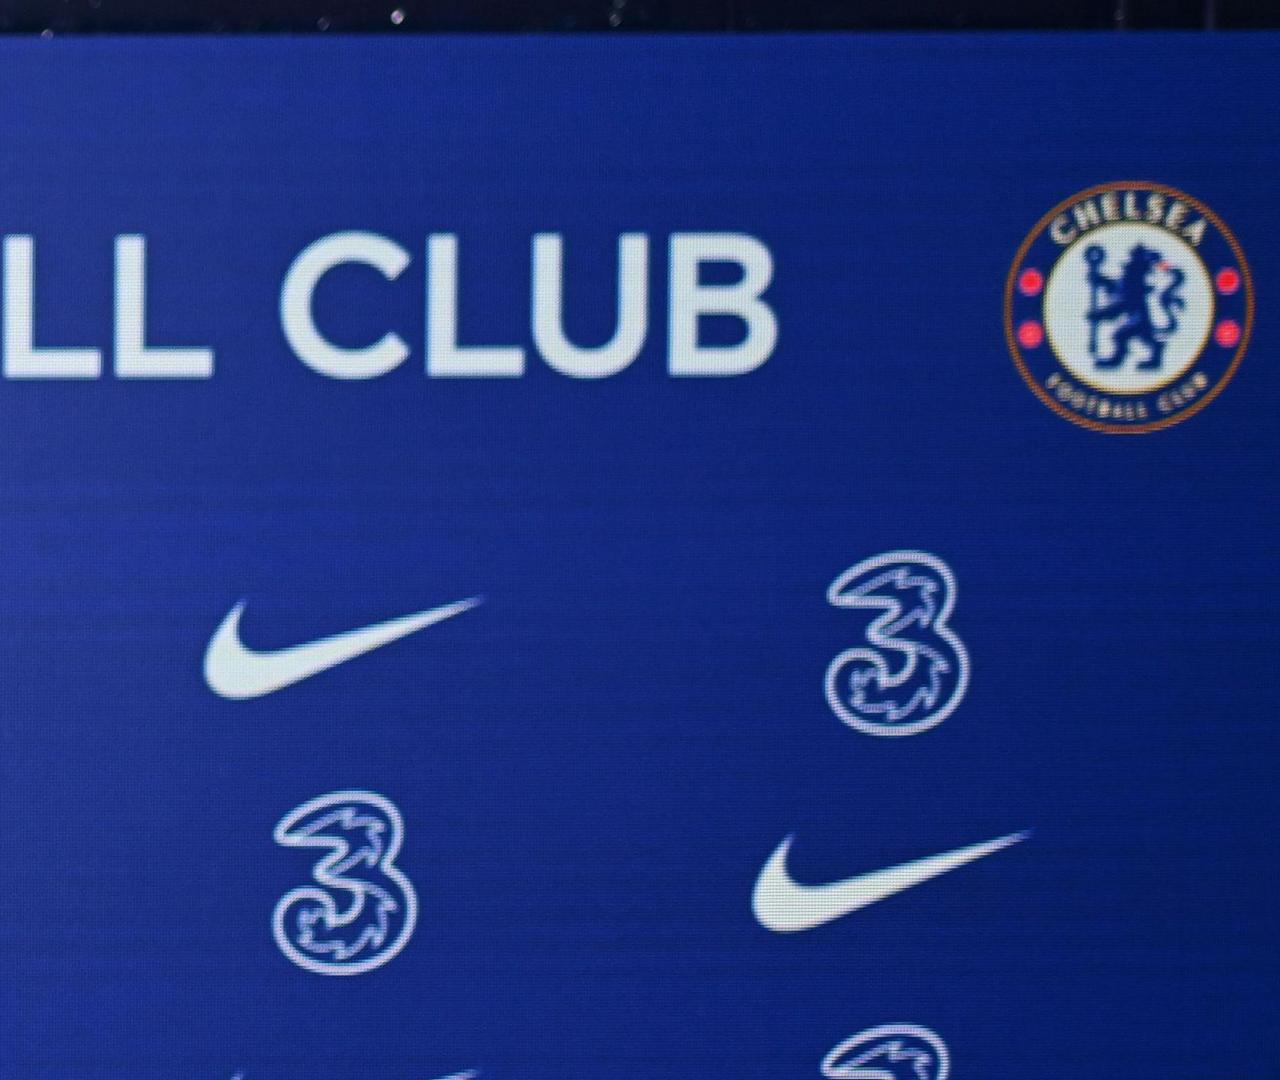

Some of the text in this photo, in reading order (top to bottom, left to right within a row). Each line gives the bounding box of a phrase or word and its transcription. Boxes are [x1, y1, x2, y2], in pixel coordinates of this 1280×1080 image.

[1049, 191, 1208, 246] CHELSEA
[281, 232, 777, 379] CLUB
[824, 551, 970, 737] 3
[272, 791, 418, 977] 3
